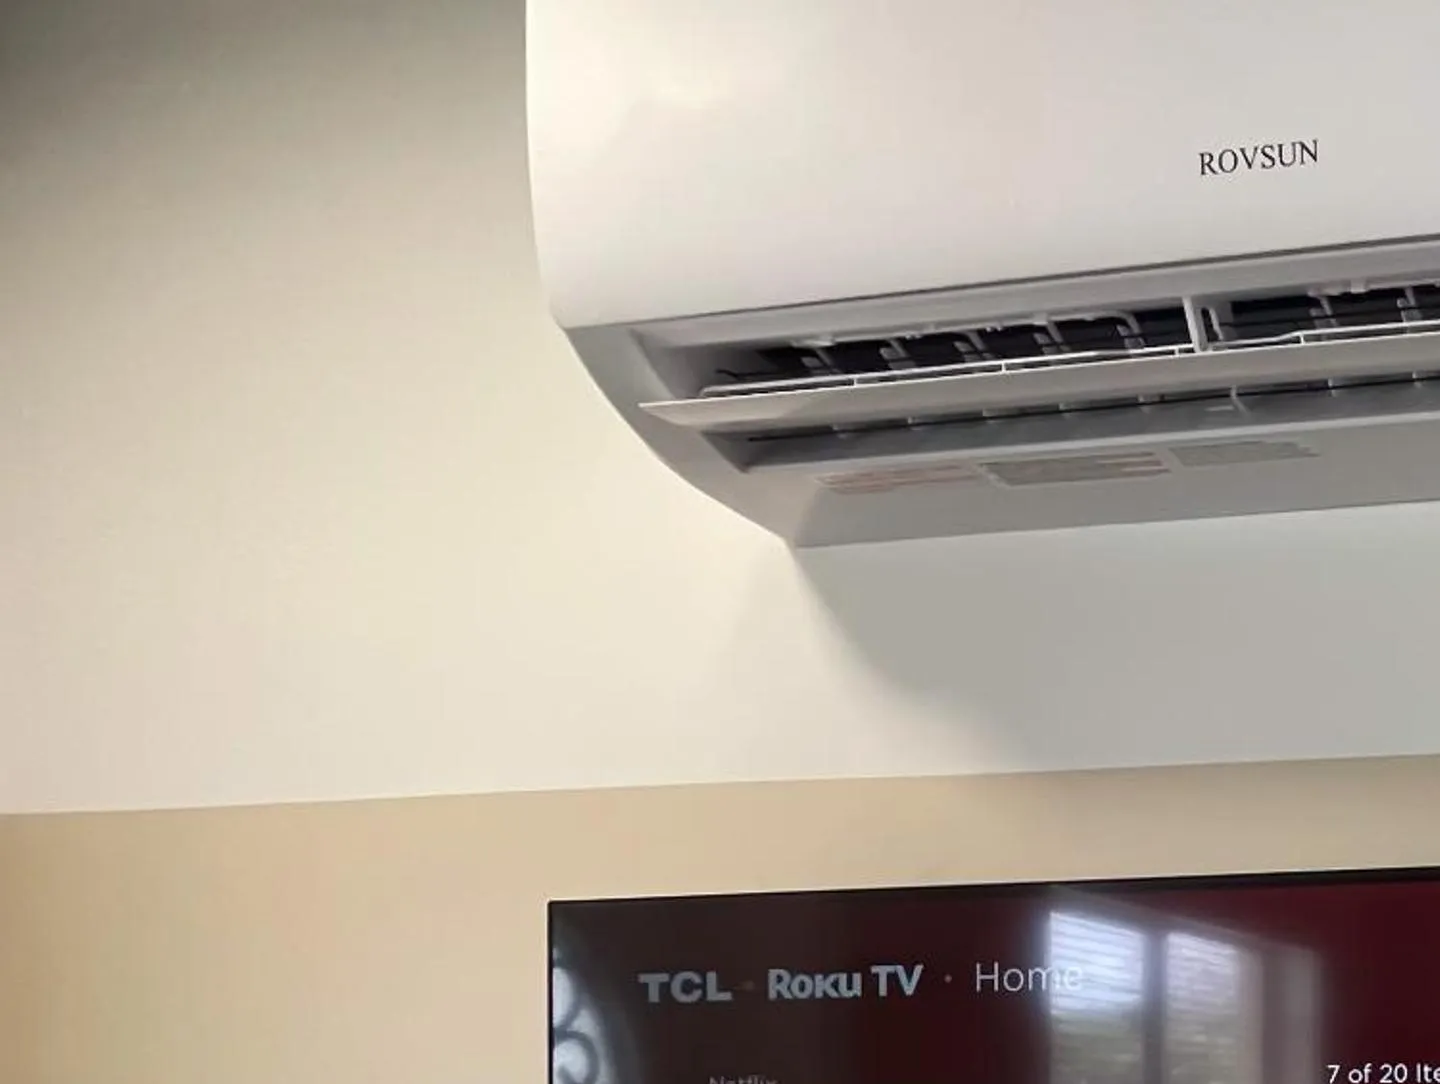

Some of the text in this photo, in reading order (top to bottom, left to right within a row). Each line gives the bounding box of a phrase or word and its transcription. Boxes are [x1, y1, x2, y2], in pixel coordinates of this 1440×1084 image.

[1198, 139, 1319, 176] ROVSUN
[638, 962, 1085, 1003] TCL Roku TV Home
[1326, 1064, 1341, 1084] 7
[1347, 1062, 1372, 1084] of
[1378, 1063, 1409, 1084] 20
